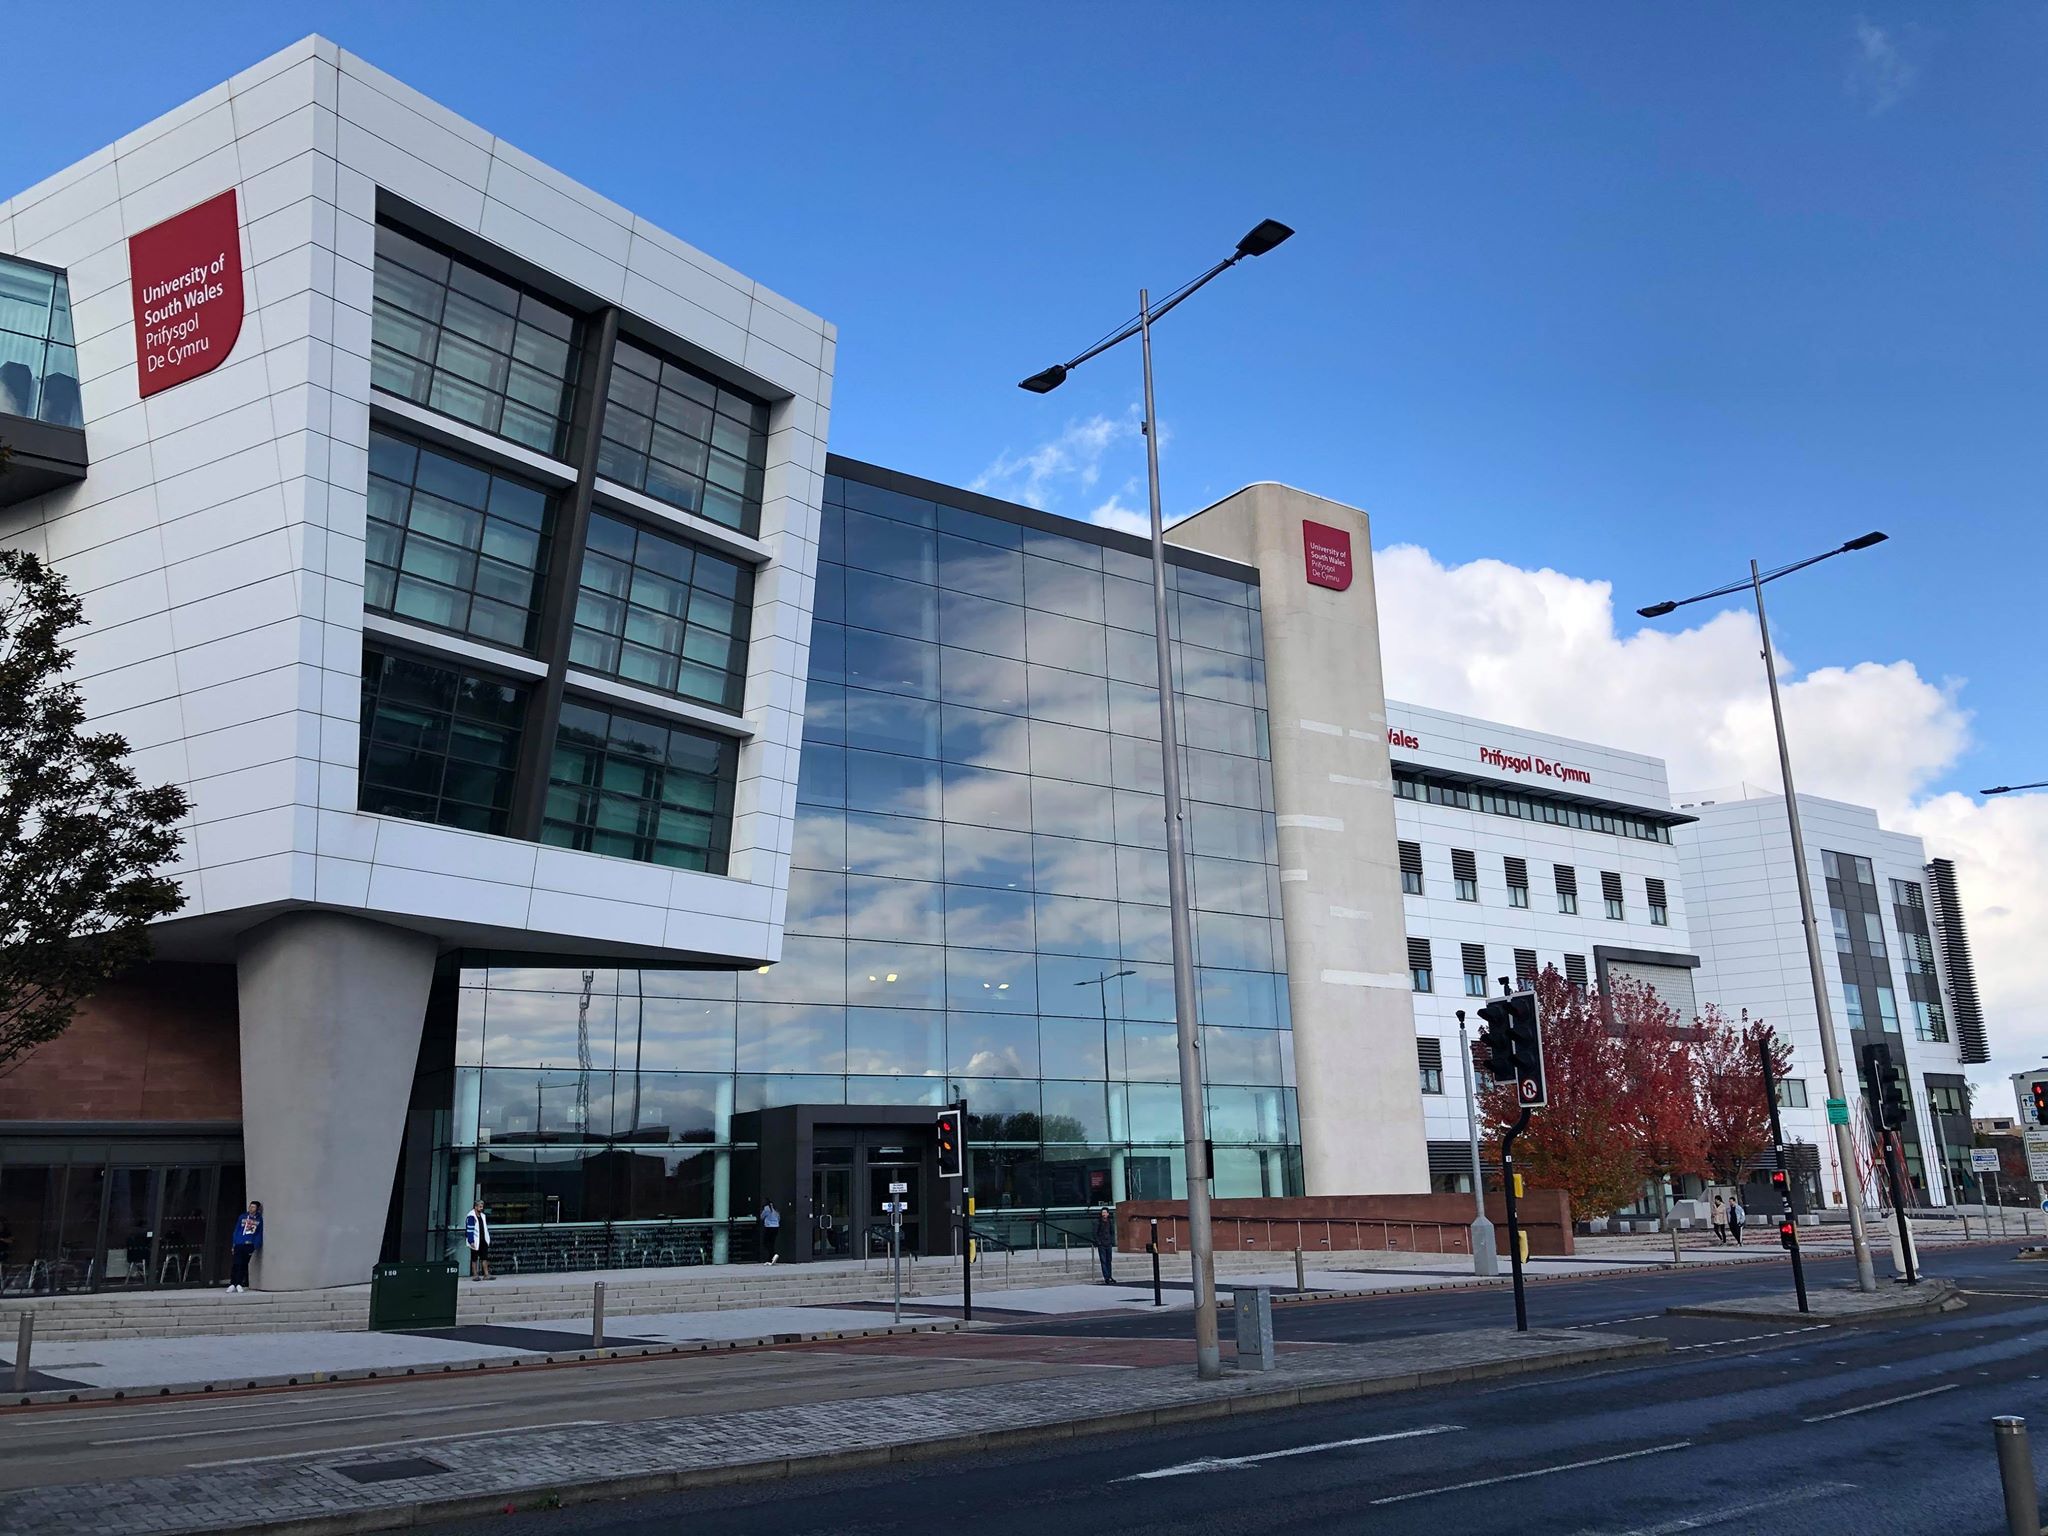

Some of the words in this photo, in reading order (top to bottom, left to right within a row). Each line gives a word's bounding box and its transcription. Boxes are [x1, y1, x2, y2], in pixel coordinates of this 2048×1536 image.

[143, 265, 208, 304] University
[210, 252, 225, 274] of
[144, 298, 182, 327] South
[184, 282, 224, 309] Wales
[146, 312, 199, 350] Prifysgol
[147, 354, 165, 373] De
[167, 336, 209, 366] Cymru
[1310, 542, 1340, 557] University
[1340, 551, 1346, 559] of
[1311, 551, 1328, 562] South
[1329, 556, 1346, 567] Wales
[1312, 569, 1320, 577] De
[1321, 571, 1340, 583] Cymru
[1480, 747, 1532, 773] Prifysgol
[1535, 758, 1552, 775] De
[1553, 762, 1591, 783] Cymru
